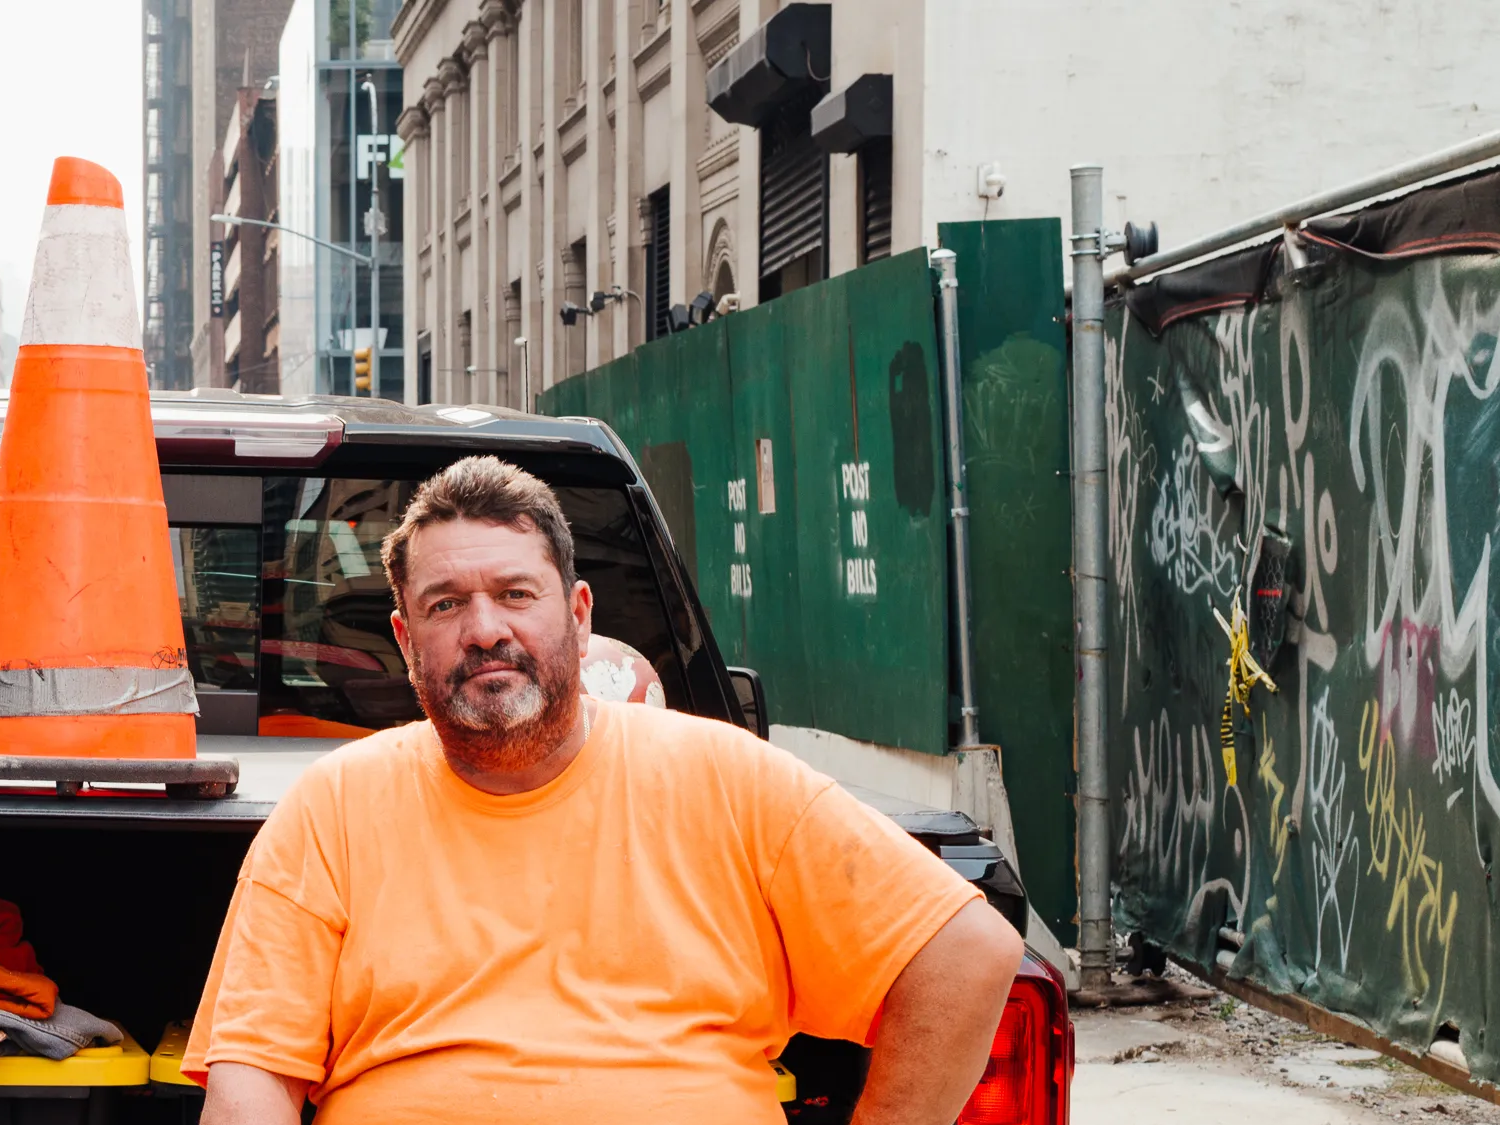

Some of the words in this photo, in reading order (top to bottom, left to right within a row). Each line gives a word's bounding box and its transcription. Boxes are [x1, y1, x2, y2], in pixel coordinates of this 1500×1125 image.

[728, 478, 746, 511] POST
[842, 462, 870, 500] POST
[734, 522, 746, 554] NO
[851, 510, 868, 548] NO
[730, 563, 752, 597] BILLS
[846, 558, 878, 596] BILLS
